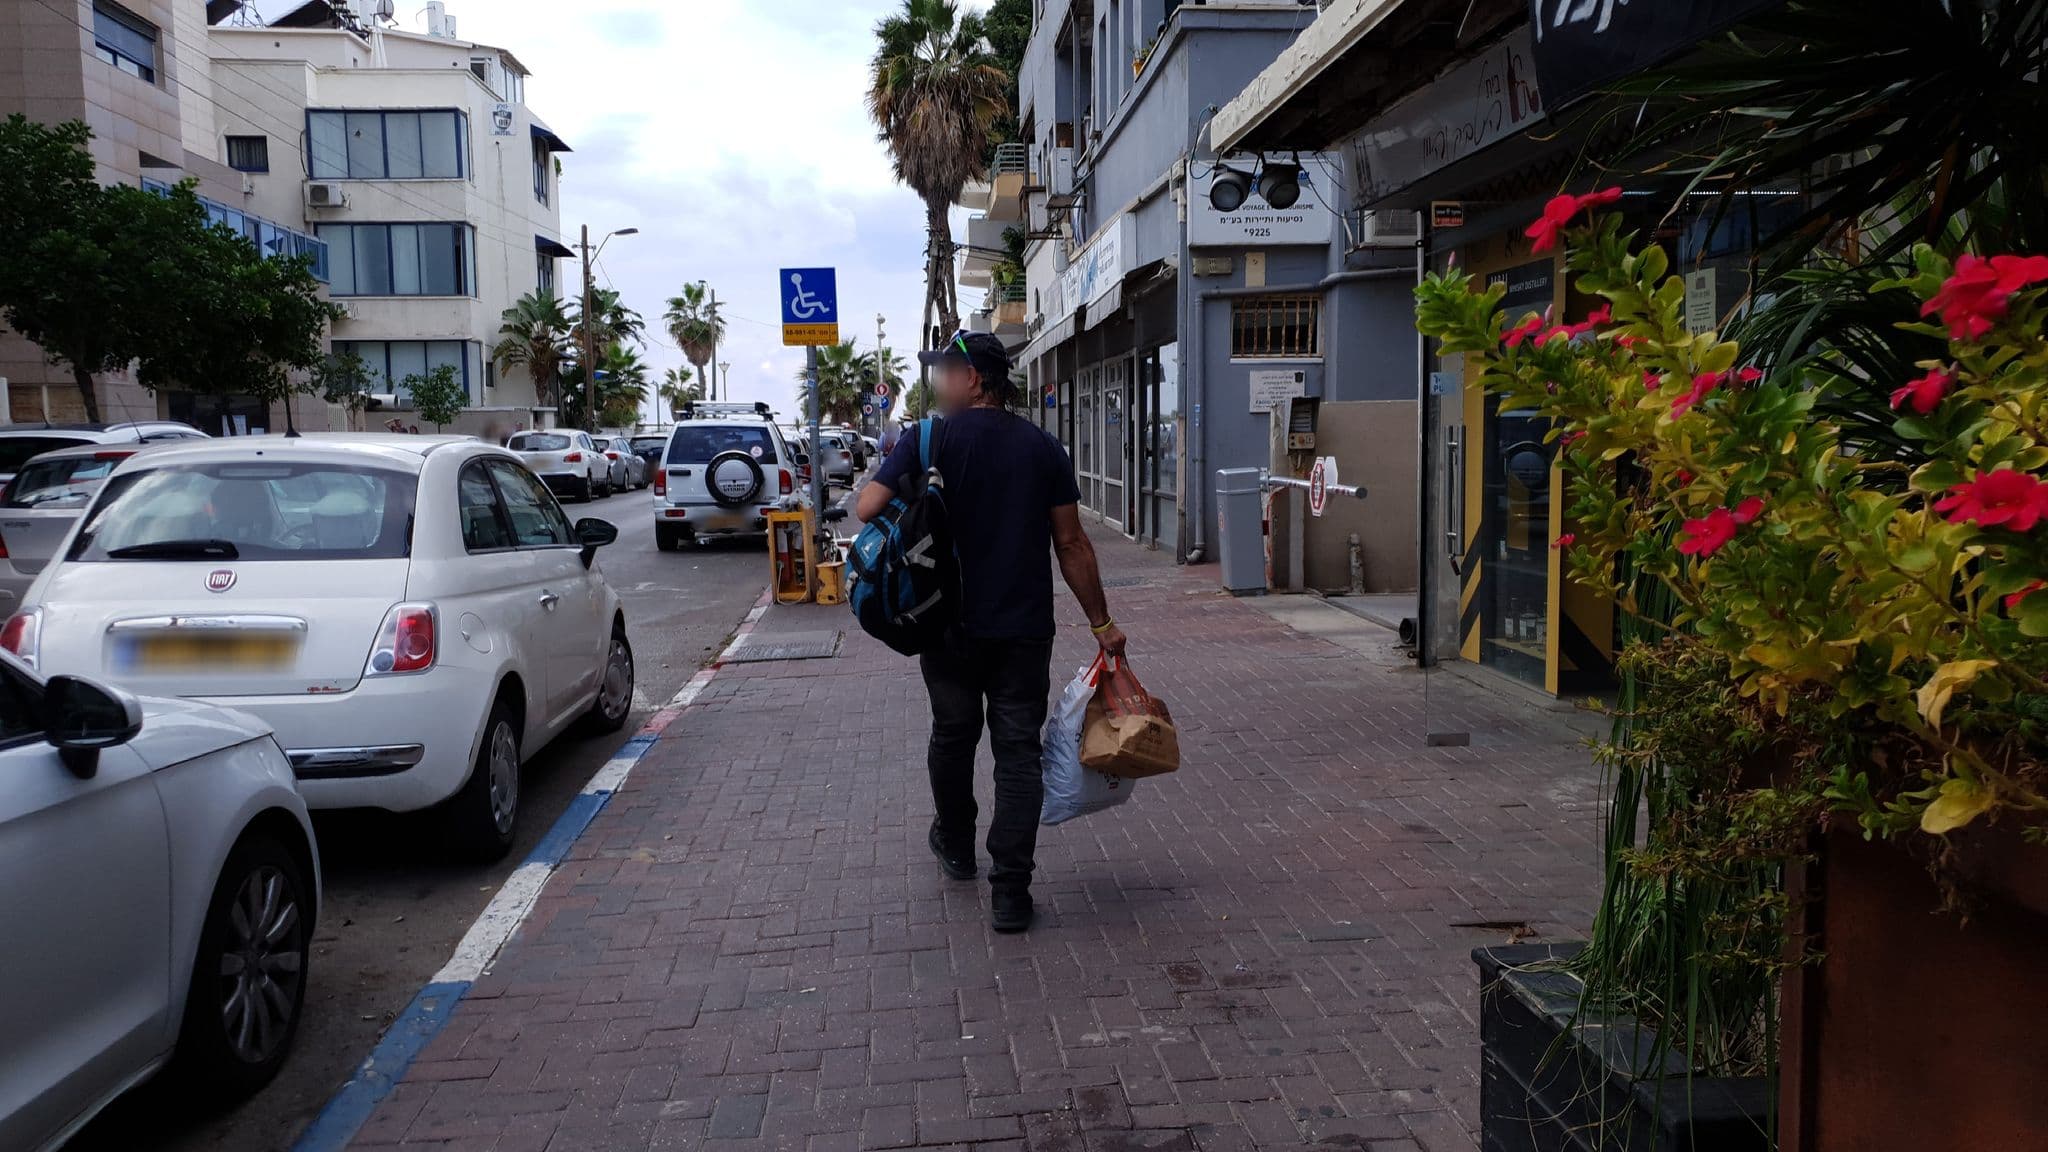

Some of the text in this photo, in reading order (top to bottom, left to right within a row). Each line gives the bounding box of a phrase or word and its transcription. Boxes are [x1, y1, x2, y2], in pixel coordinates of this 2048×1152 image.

[1245, 215, 1274, 223] ותיירות
[1276, 215, 1304, 223] נסיעות
[211, 574, 231, 586] FIAT
